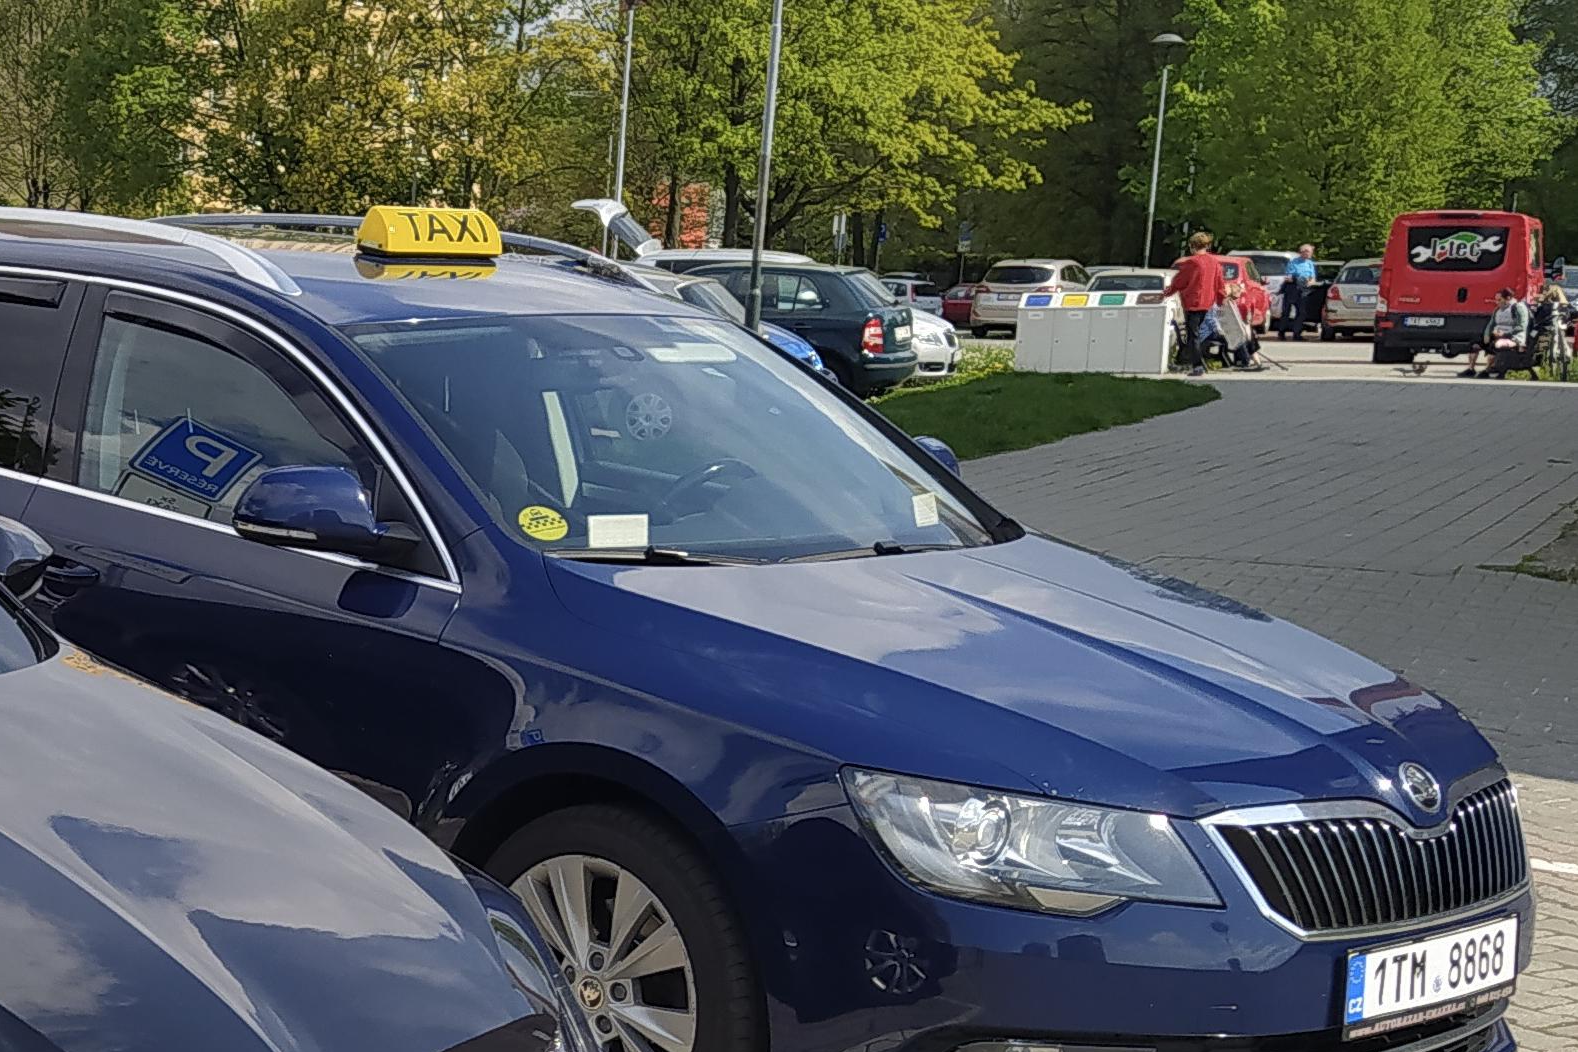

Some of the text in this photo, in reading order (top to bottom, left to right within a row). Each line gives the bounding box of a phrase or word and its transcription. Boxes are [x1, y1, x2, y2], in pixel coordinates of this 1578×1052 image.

[397, 211, 489, 243] TAXI
[1374, 930, 1505, 1006] 1TM 8868
[1348, 996, 1364, 1014] CZ
